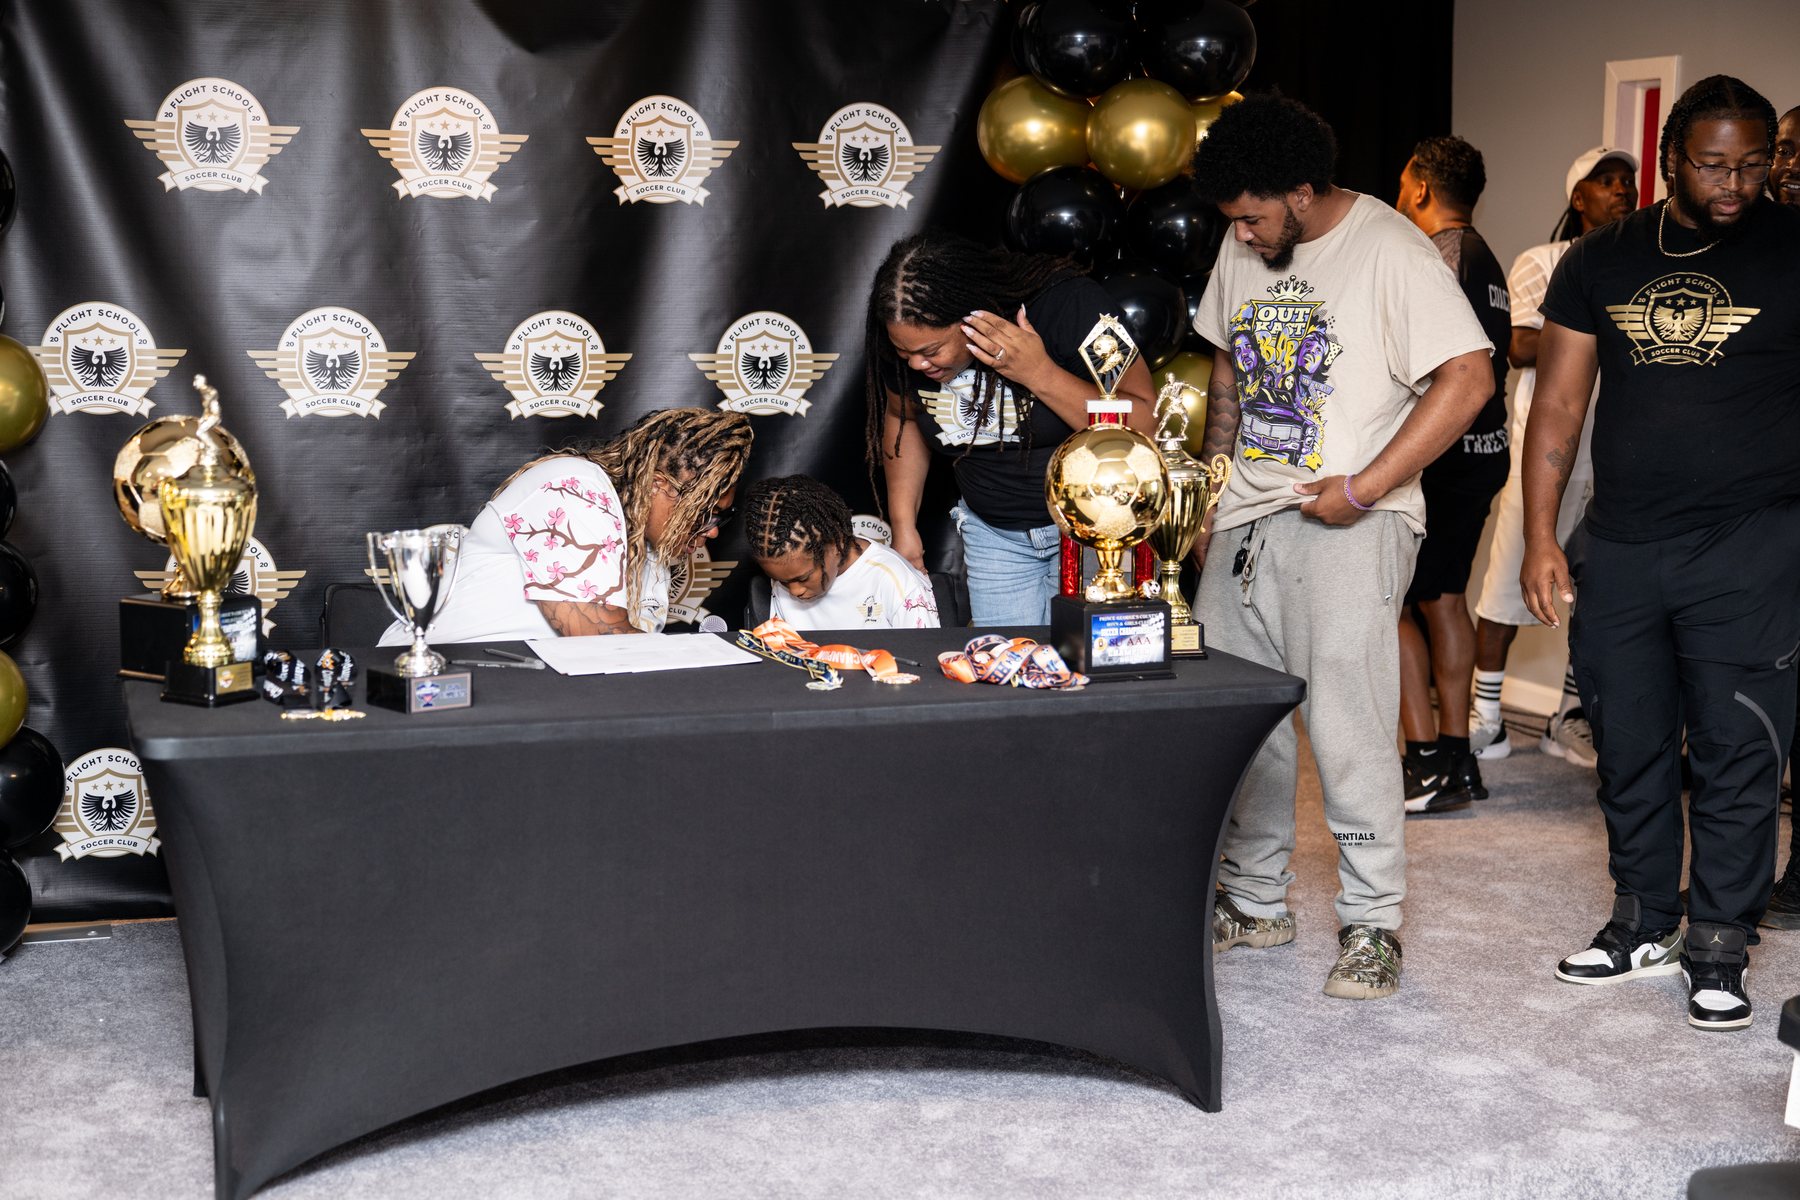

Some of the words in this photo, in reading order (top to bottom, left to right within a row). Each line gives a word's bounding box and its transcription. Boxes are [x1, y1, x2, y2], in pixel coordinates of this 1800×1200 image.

[169, 84, 207, 109] FLIGHT
[212, 84, 255, 114] SCHOOL
[404, 94, 440, 119] FLIGHT
[444, 94, 486, 121] SCHOOL
[164, 111, 174, 119] 20
[625, 102, 657, 126] FLIGHT
[661, 102, 698, 129] SCHOOL
[830, 109, 861, 133] FLIGHT
[865, 109, 901, 135] SCHOOL
[184, 171, 218, 182] SOCCER
[220, 173, 243, 184] CLUB
[417, 178, 448, 190] SOCCER
[449, 180, 473, 191] CLUB
[635, 184, 664, 195] SOCCER
[666, 185, 686, 196] CLUB
[841, 188, 869, 200] SOCCER
[871, 190, 891, 200] CLUB
[1645, 278, 1681, 296] FLIGHT
[1685, 278, 1721, 298] SCHOOL
[1257, 306, 1311, 323] OUT
[55, 309, 92, 334] FLIGHT
[97, 308, 142, 337] SCHOOL
[291, 314, 327, 339] FLIGHT
[332, 314, 373, 341] SCHOOL
[1255, 322, 1306, 336] KAST
[517, 317, 551, 342] FLIGHT
[556, 317, 594, 343] SCHOOL
[728, 318, 761, 343] FLIGHT
[764, 318, 801, 343] SCHOOL
[1651, 348, 1680, 357] SOCCER
[1682, 348, 1700, 358] CLUB
[70, 394, 105, 406] SOCCER
[106, 395, 129, 407] CLUB
[305, 398, 338, 409] SOCCER
[340, 398, 362, 410] CLUB
[529, 399, 560, 410] SOCCER
[562, 399, 582, 410] CLUB
[740, 398, 769, 408] SOCCER
[770, 398, 789, 408] CLUB
[861, 521, 891, 542] SCHOOL
[668, 607, 687, 616] CLUB
[1127, 636, 1151, 647] AAA
[67, 755, 103, 783] FLIGHT
[81, 839, 114, 851] SOCCER
[117, 839, 138, 848] CLUB
